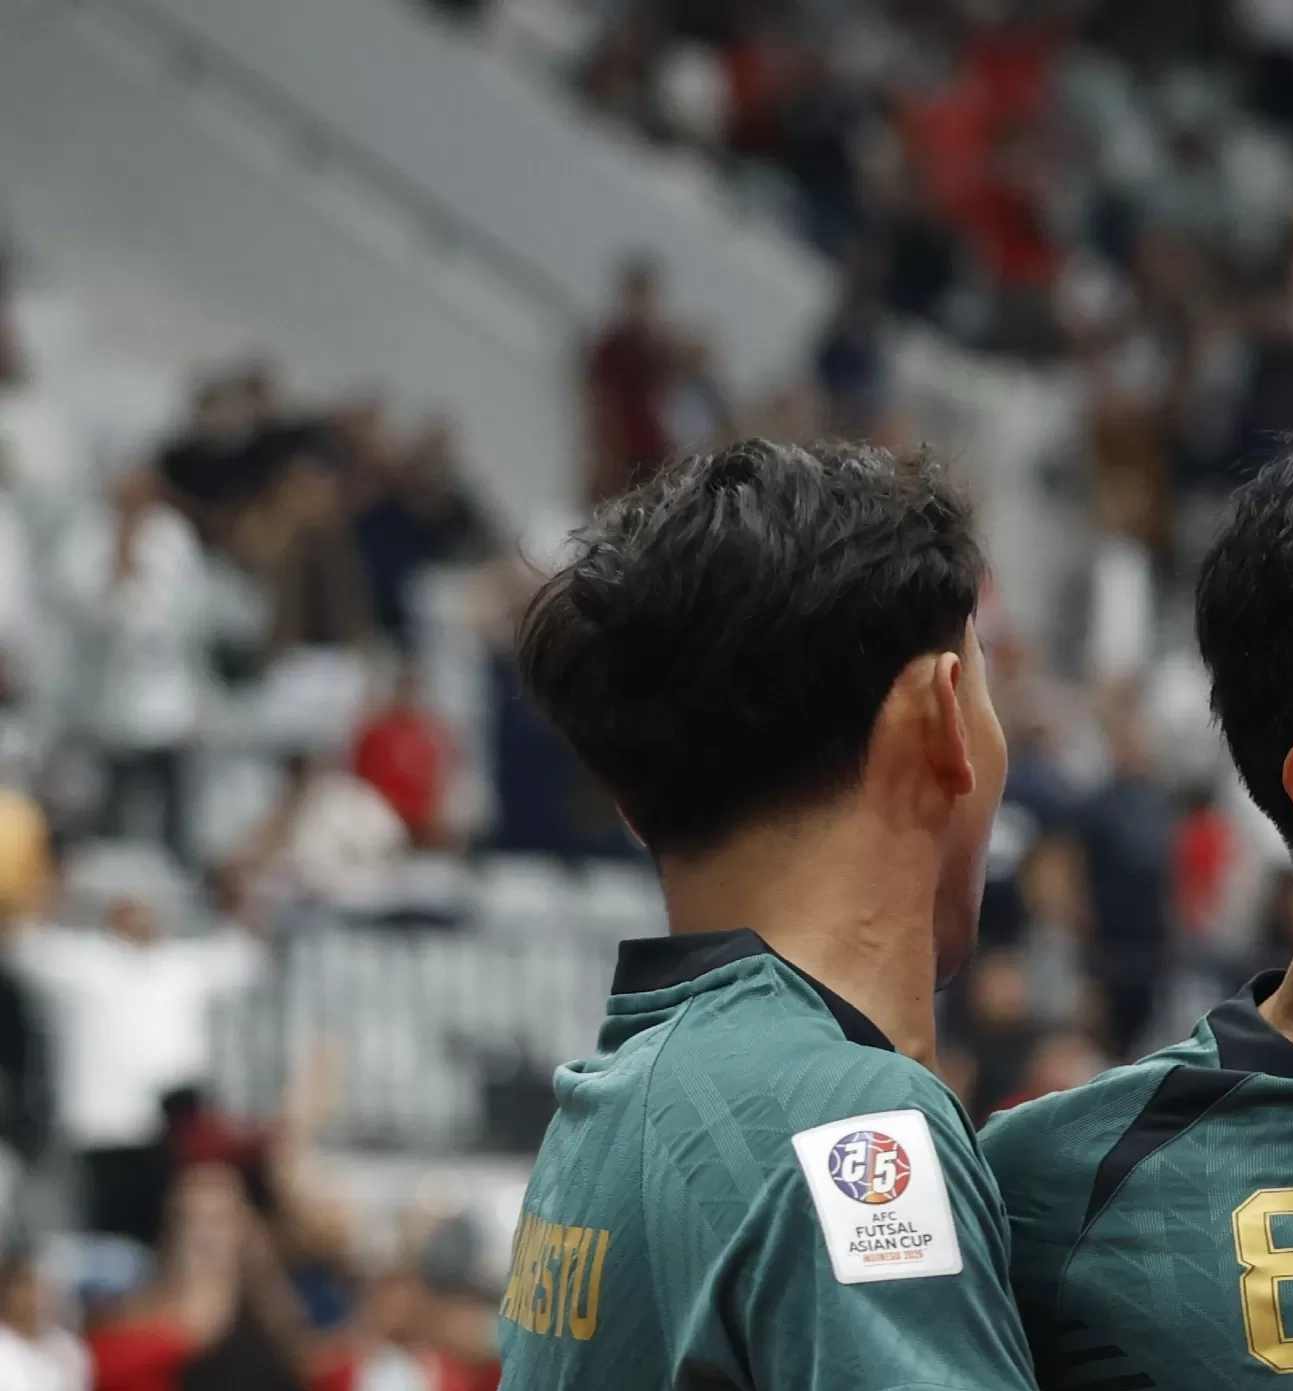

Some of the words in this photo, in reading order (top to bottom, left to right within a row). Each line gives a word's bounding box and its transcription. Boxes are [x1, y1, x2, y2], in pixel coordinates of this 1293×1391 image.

[872, 1212, 897, 1221] AFC
[856, 1222, 917, 1238] FUTSAL
[849, 1238, 897, 1252] ASIAN
[900, 1234, 932, 1248] CUP
